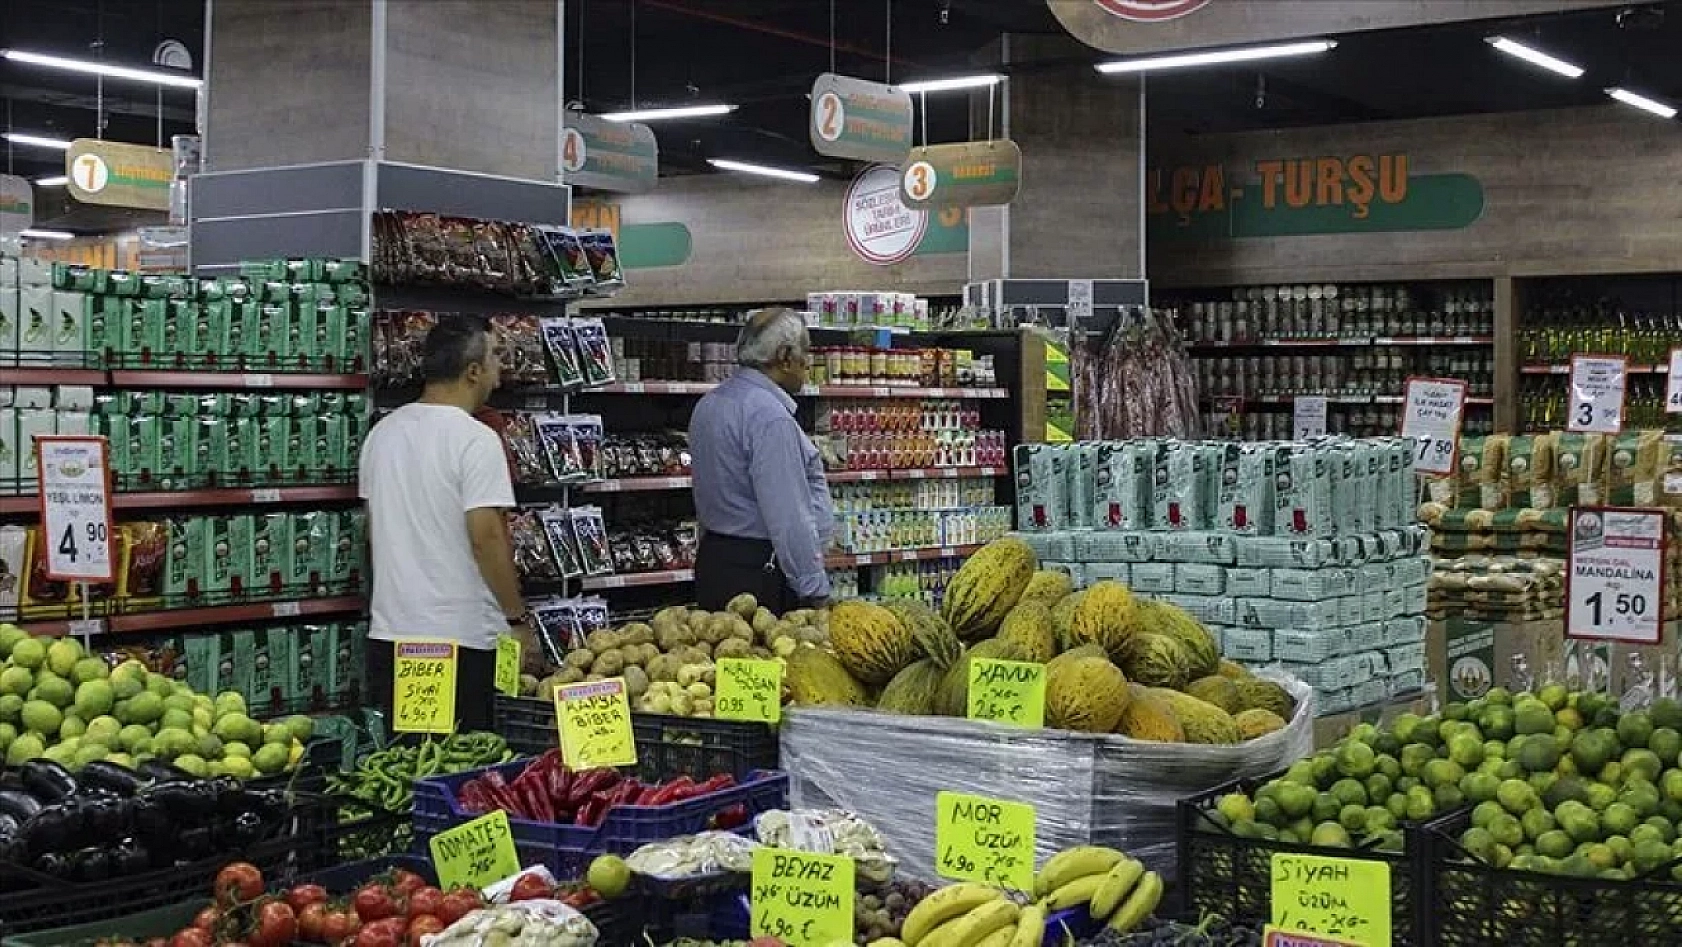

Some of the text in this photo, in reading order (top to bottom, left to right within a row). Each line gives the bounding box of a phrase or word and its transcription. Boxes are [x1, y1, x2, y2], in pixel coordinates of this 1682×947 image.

[823, 97, 837, 135] 2
[564, 132, 578, 167] 4
[82, 159, 98, 189] 7
[912, 165, 928, 197] 3
[1256, 155, 1408, 219] TURŞU
[1577, 402, 1593, 426] 3
[1420, 439, 1452, 460] 7 50
[59, 521, 107, 563] 4 90
[1576, 565, 1655, 582] MANDALİNA
[1584, 591, 1646, 626] 1 50
[973, 662, 1039, 686] KAVUN
[951, 801, 1002, 825] MOR
[438, 818, 508, 863] DOMATES
[771, 855, 835, 881] BEYAZ
[1275, 859, 1350, 885] SİYAH
[786, 885, 840, 910] ÜZÜM
